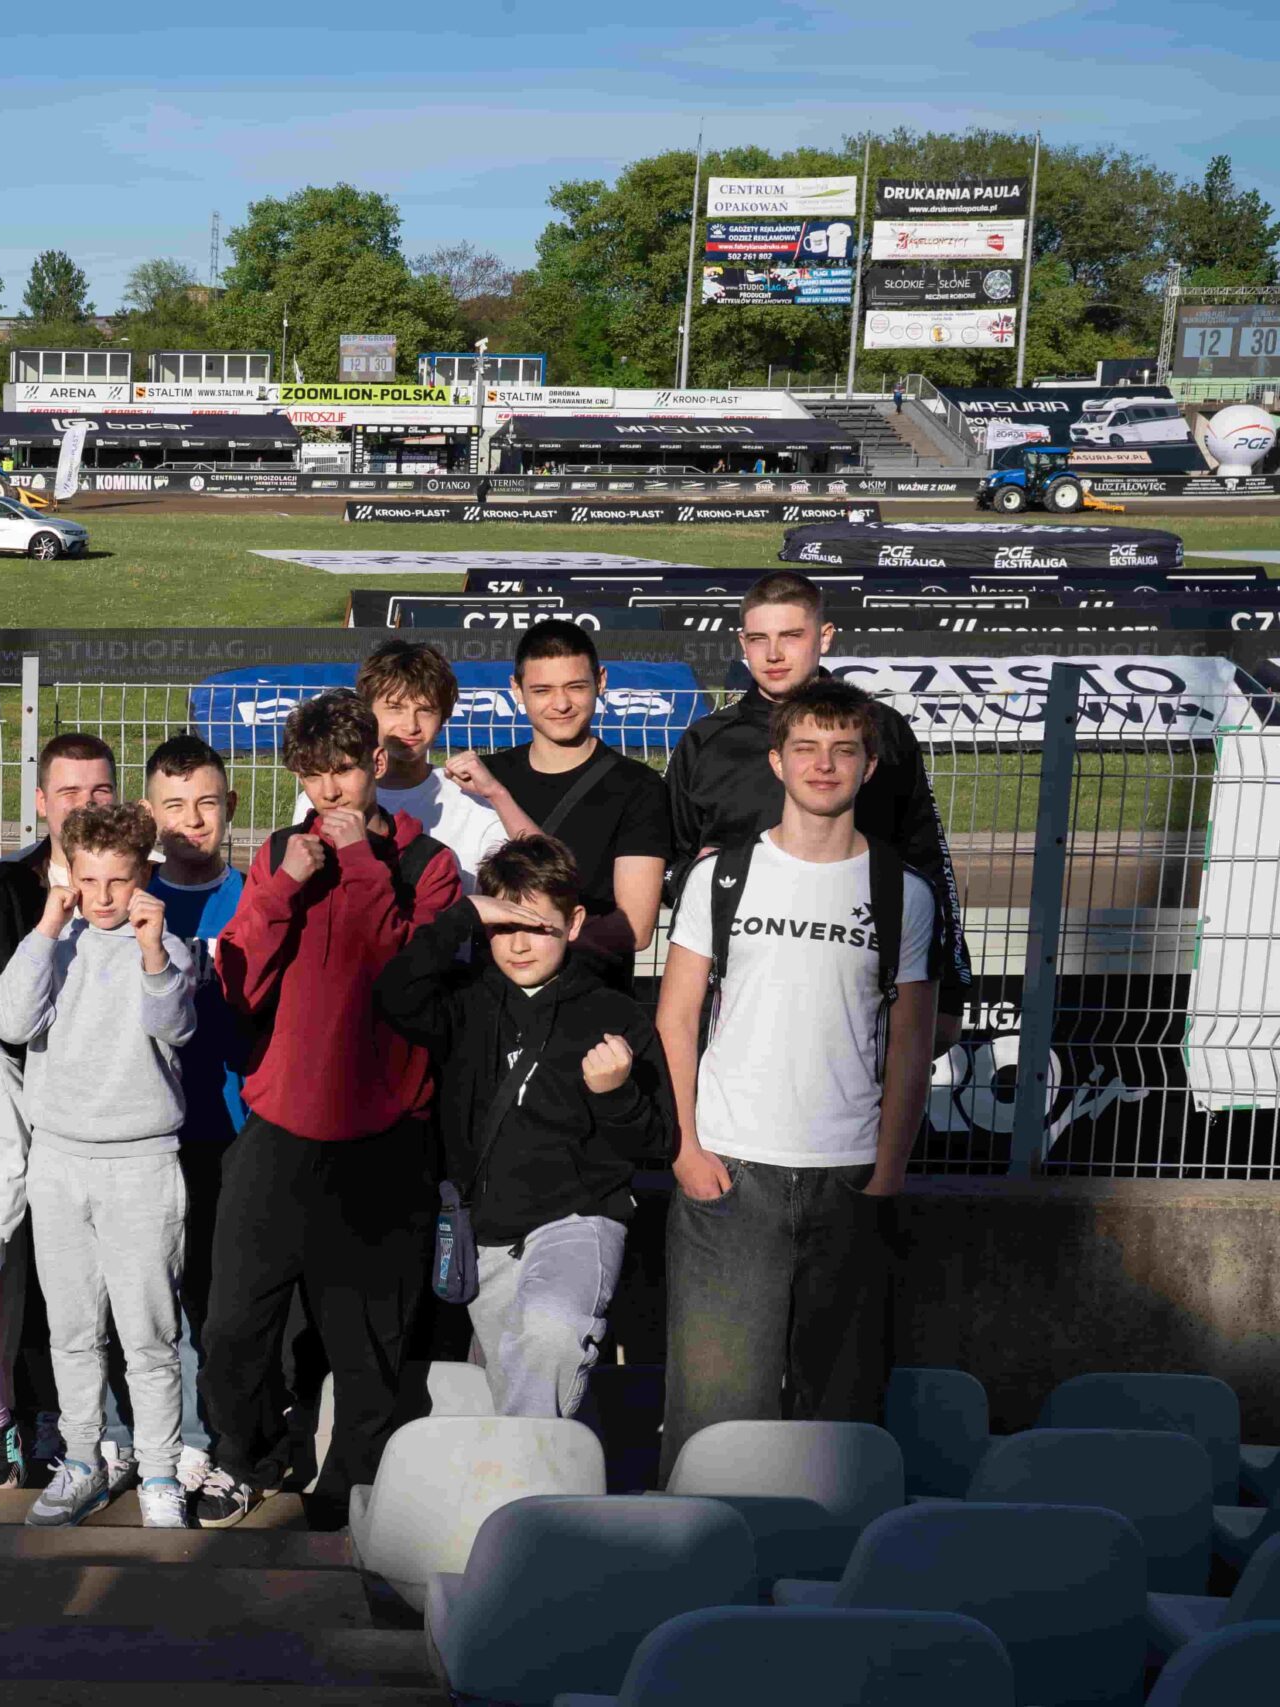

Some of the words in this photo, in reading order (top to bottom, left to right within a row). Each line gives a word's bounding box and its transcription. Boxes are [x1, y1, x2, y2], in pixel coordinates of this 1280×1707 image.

[720, 184, 784, 194] CENTRUM
[884, 186, 971, 200] DRUKARNIA
[973, 185, 1020, 200] PAULA
[714, 200, 789, 212] OPAKOWAŃ
[884, 280, 925, 289] SŁODKIE
[938, 279, 971, 288] SŁONE
[1198, 330, 1222, 356] 12
[1251, 329, 1278, 354] 30
[351, 358, 360, 370] 12
[375, 358, 386, 370] 30
[50, 388, 96, 398] ARENA
[148, 388, 192, 396] STALTIM
[282, 388, 446, 400] ZOOMLION-POLSKA
[499, 392, 542, 401] STALTIM
[672, 396, 739, 404] KRONO-PLAST
[959, 401, 1070, 412] MASURIA
[106, 421, 194, 431] bocar
[614, 424, 754, 434] MASURIA
[1233, 438, 1271, 450] PGE
[96, 474, 152, 490] KOMINKI
[440, 482, 470, 490] TANGO
[868, 480, 886, 488] KIM
[898, 482, 928, 491] WAŻNE
[938, 484, 957, 492] KIM!
[482, 510, 554, 518] KRONO-PLAST
[590, 510, 660, 518] KRONO-PLAST
[696, 510, 766, 518] KRONO-PLAST
[802, 542, 822, 554] PGE
[879, 546, 914, 558] PGE
[995, 546, 1034, 559] PGE
[1110, 544, 1138, 556] PGE
[800, 552, 842, 564] EKSTRALIGA
[878, 558, 946, 568] EKSTRALIGA
[994, 558, 1068, 568] EKSTRALIGA
[1110, 556, 1158, 566] EKSTRALIGA
[943, 857, 961, 921] EXTREME
[730, 916, 880, 953] CONVERSE
